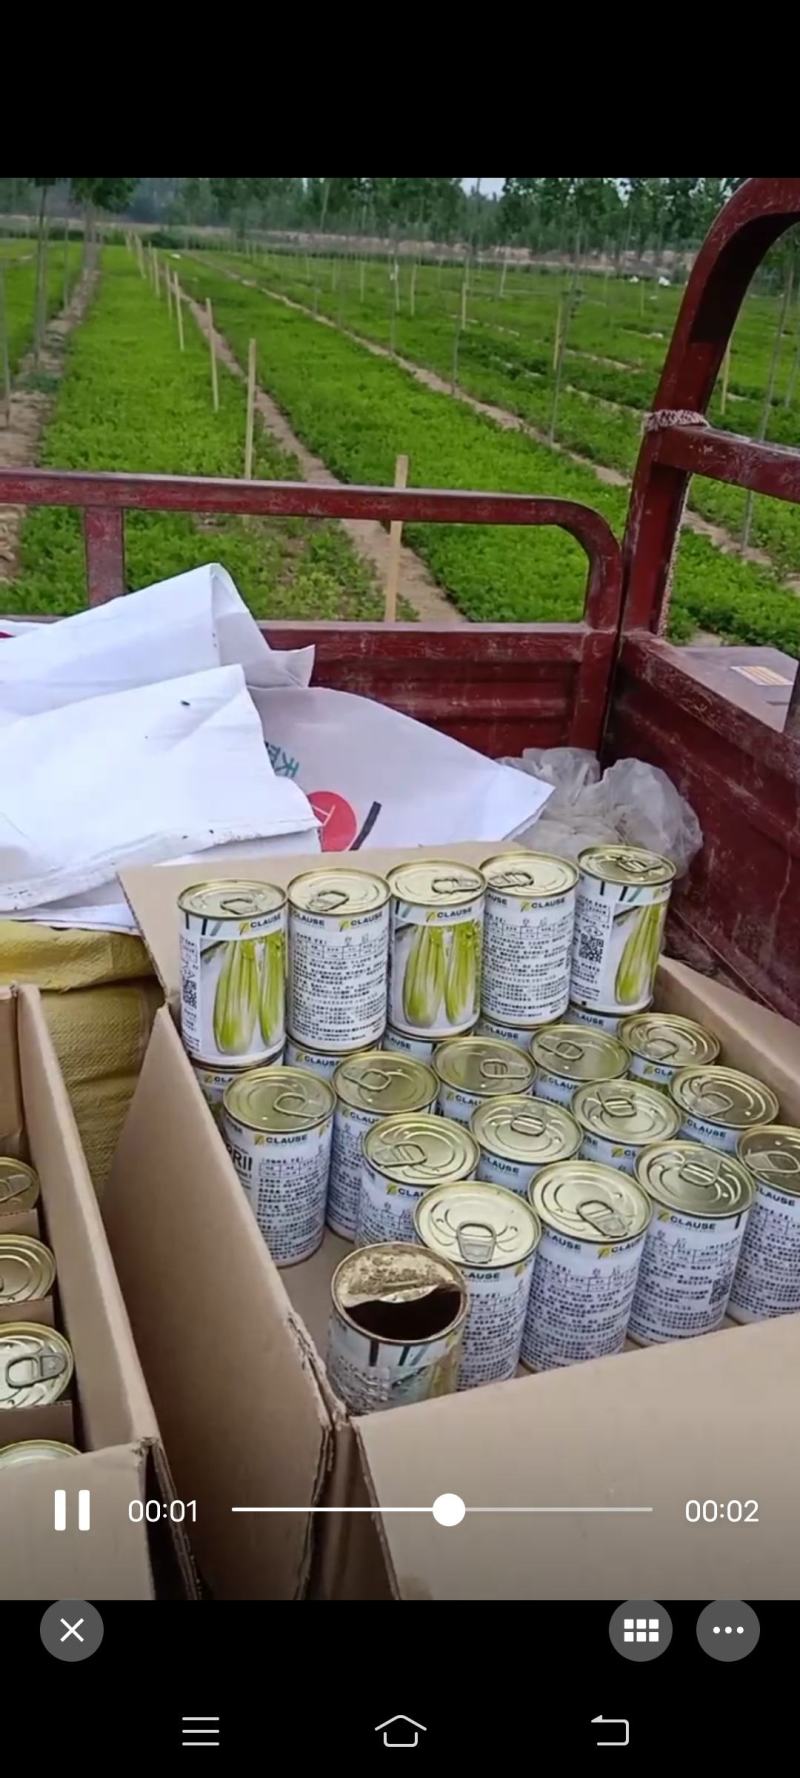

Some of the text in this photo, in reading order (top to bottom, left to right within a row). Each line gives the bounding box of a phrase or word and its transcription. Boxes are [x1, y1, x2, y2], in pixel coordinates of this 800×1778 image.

[531, 897, 565, 909] CLAUSE
[351, 911, 383, 926] CLAUSE
[437, 907, 472, 919] CLAUSE
[250, 914, 281, 928] CLAUSE
[687, 1118, 727, 1138] CLAUSE
[266, 1134, 307, 1144] CLAUSE
[482, 1155, 520, 1173] LAUSE
[671, 1215, 717, 1230] CLAUSE
